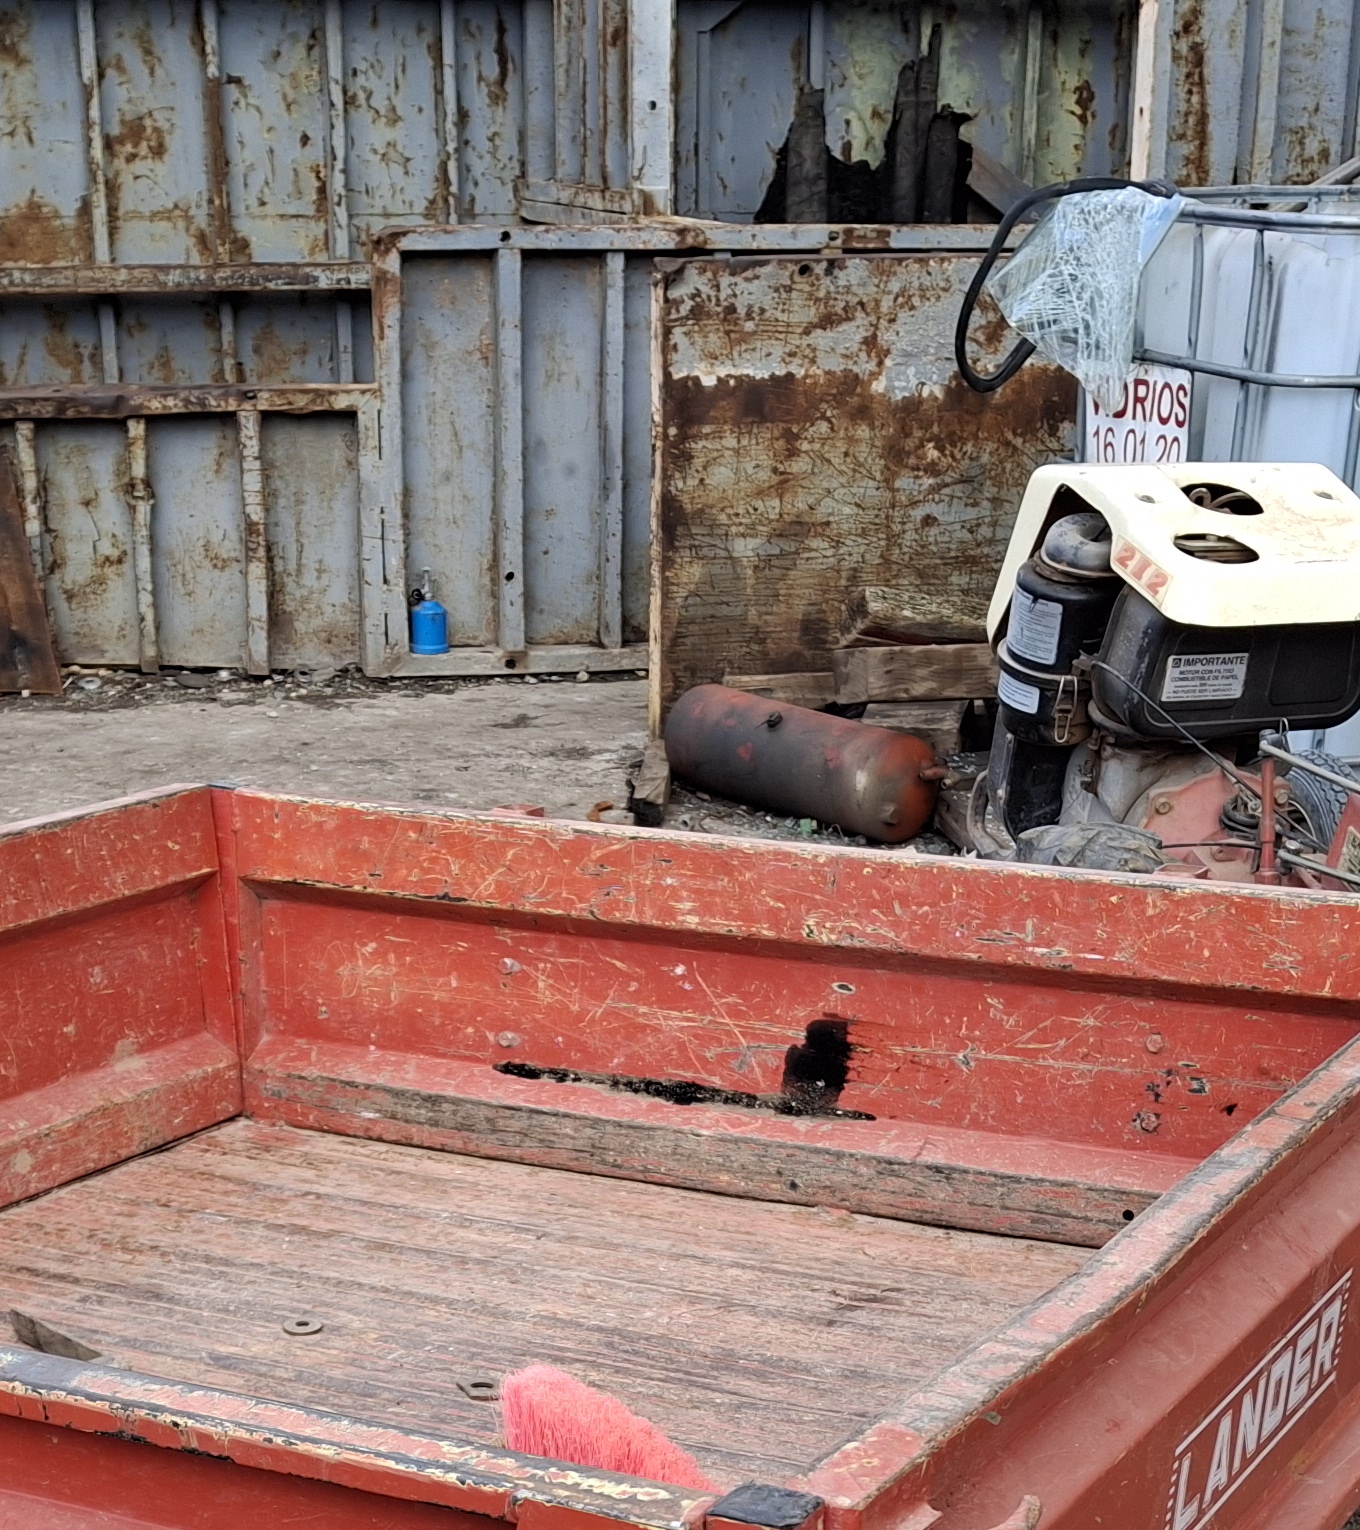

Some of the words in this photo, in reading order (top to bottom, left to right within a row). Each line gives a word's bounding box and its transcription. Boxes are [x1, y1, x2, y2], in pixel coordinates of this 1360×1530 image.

[1093, 378, 1188, 428] RIOS
[1093, 425, 1115, 463] 16
[1124, 429, 1147, 463] 01
[1155, 434, 1181, 463] 20
[1183, 656, 1247, 667] IMPORTANTE
